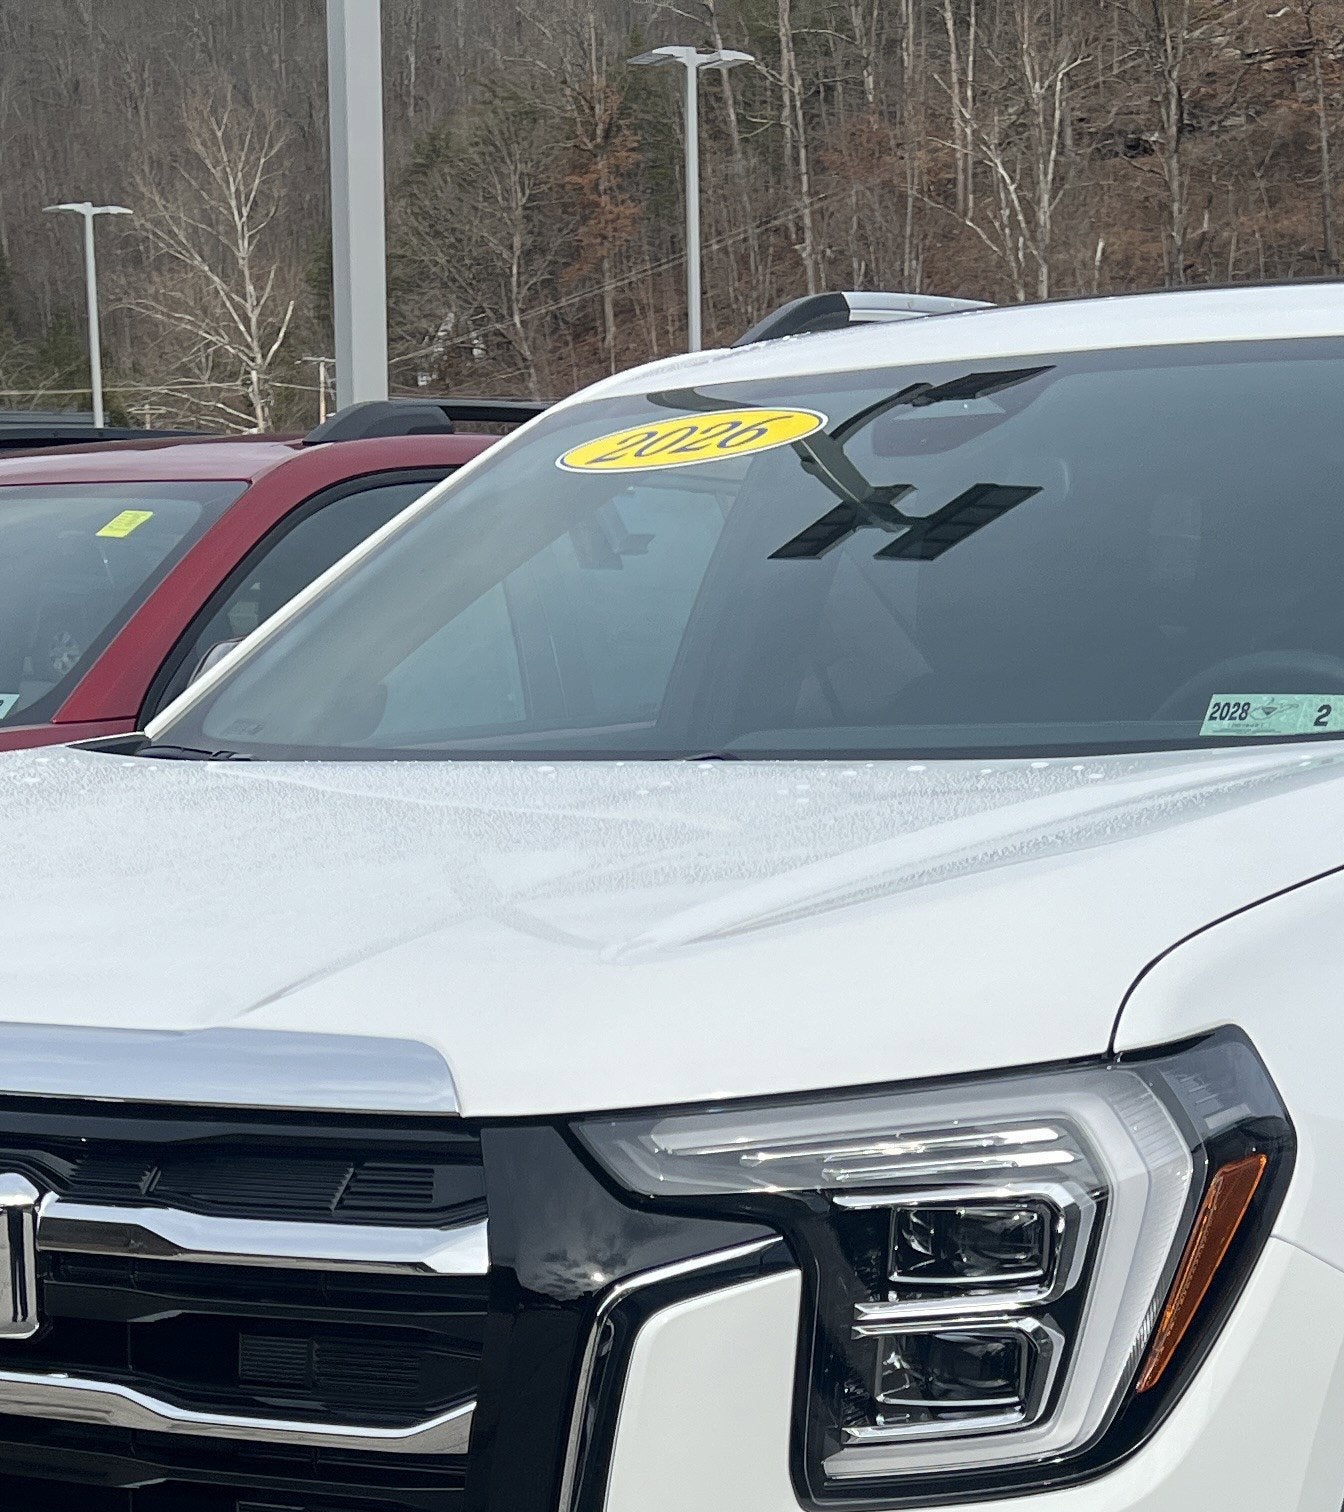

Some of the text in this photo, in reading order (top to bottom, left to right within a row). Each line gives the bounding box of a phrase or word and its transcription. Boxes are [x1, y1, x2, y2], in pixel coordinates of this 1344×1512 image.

[585, 415, 795, 465] 2026
[1208, 702, 1332, 727] 2028 2
